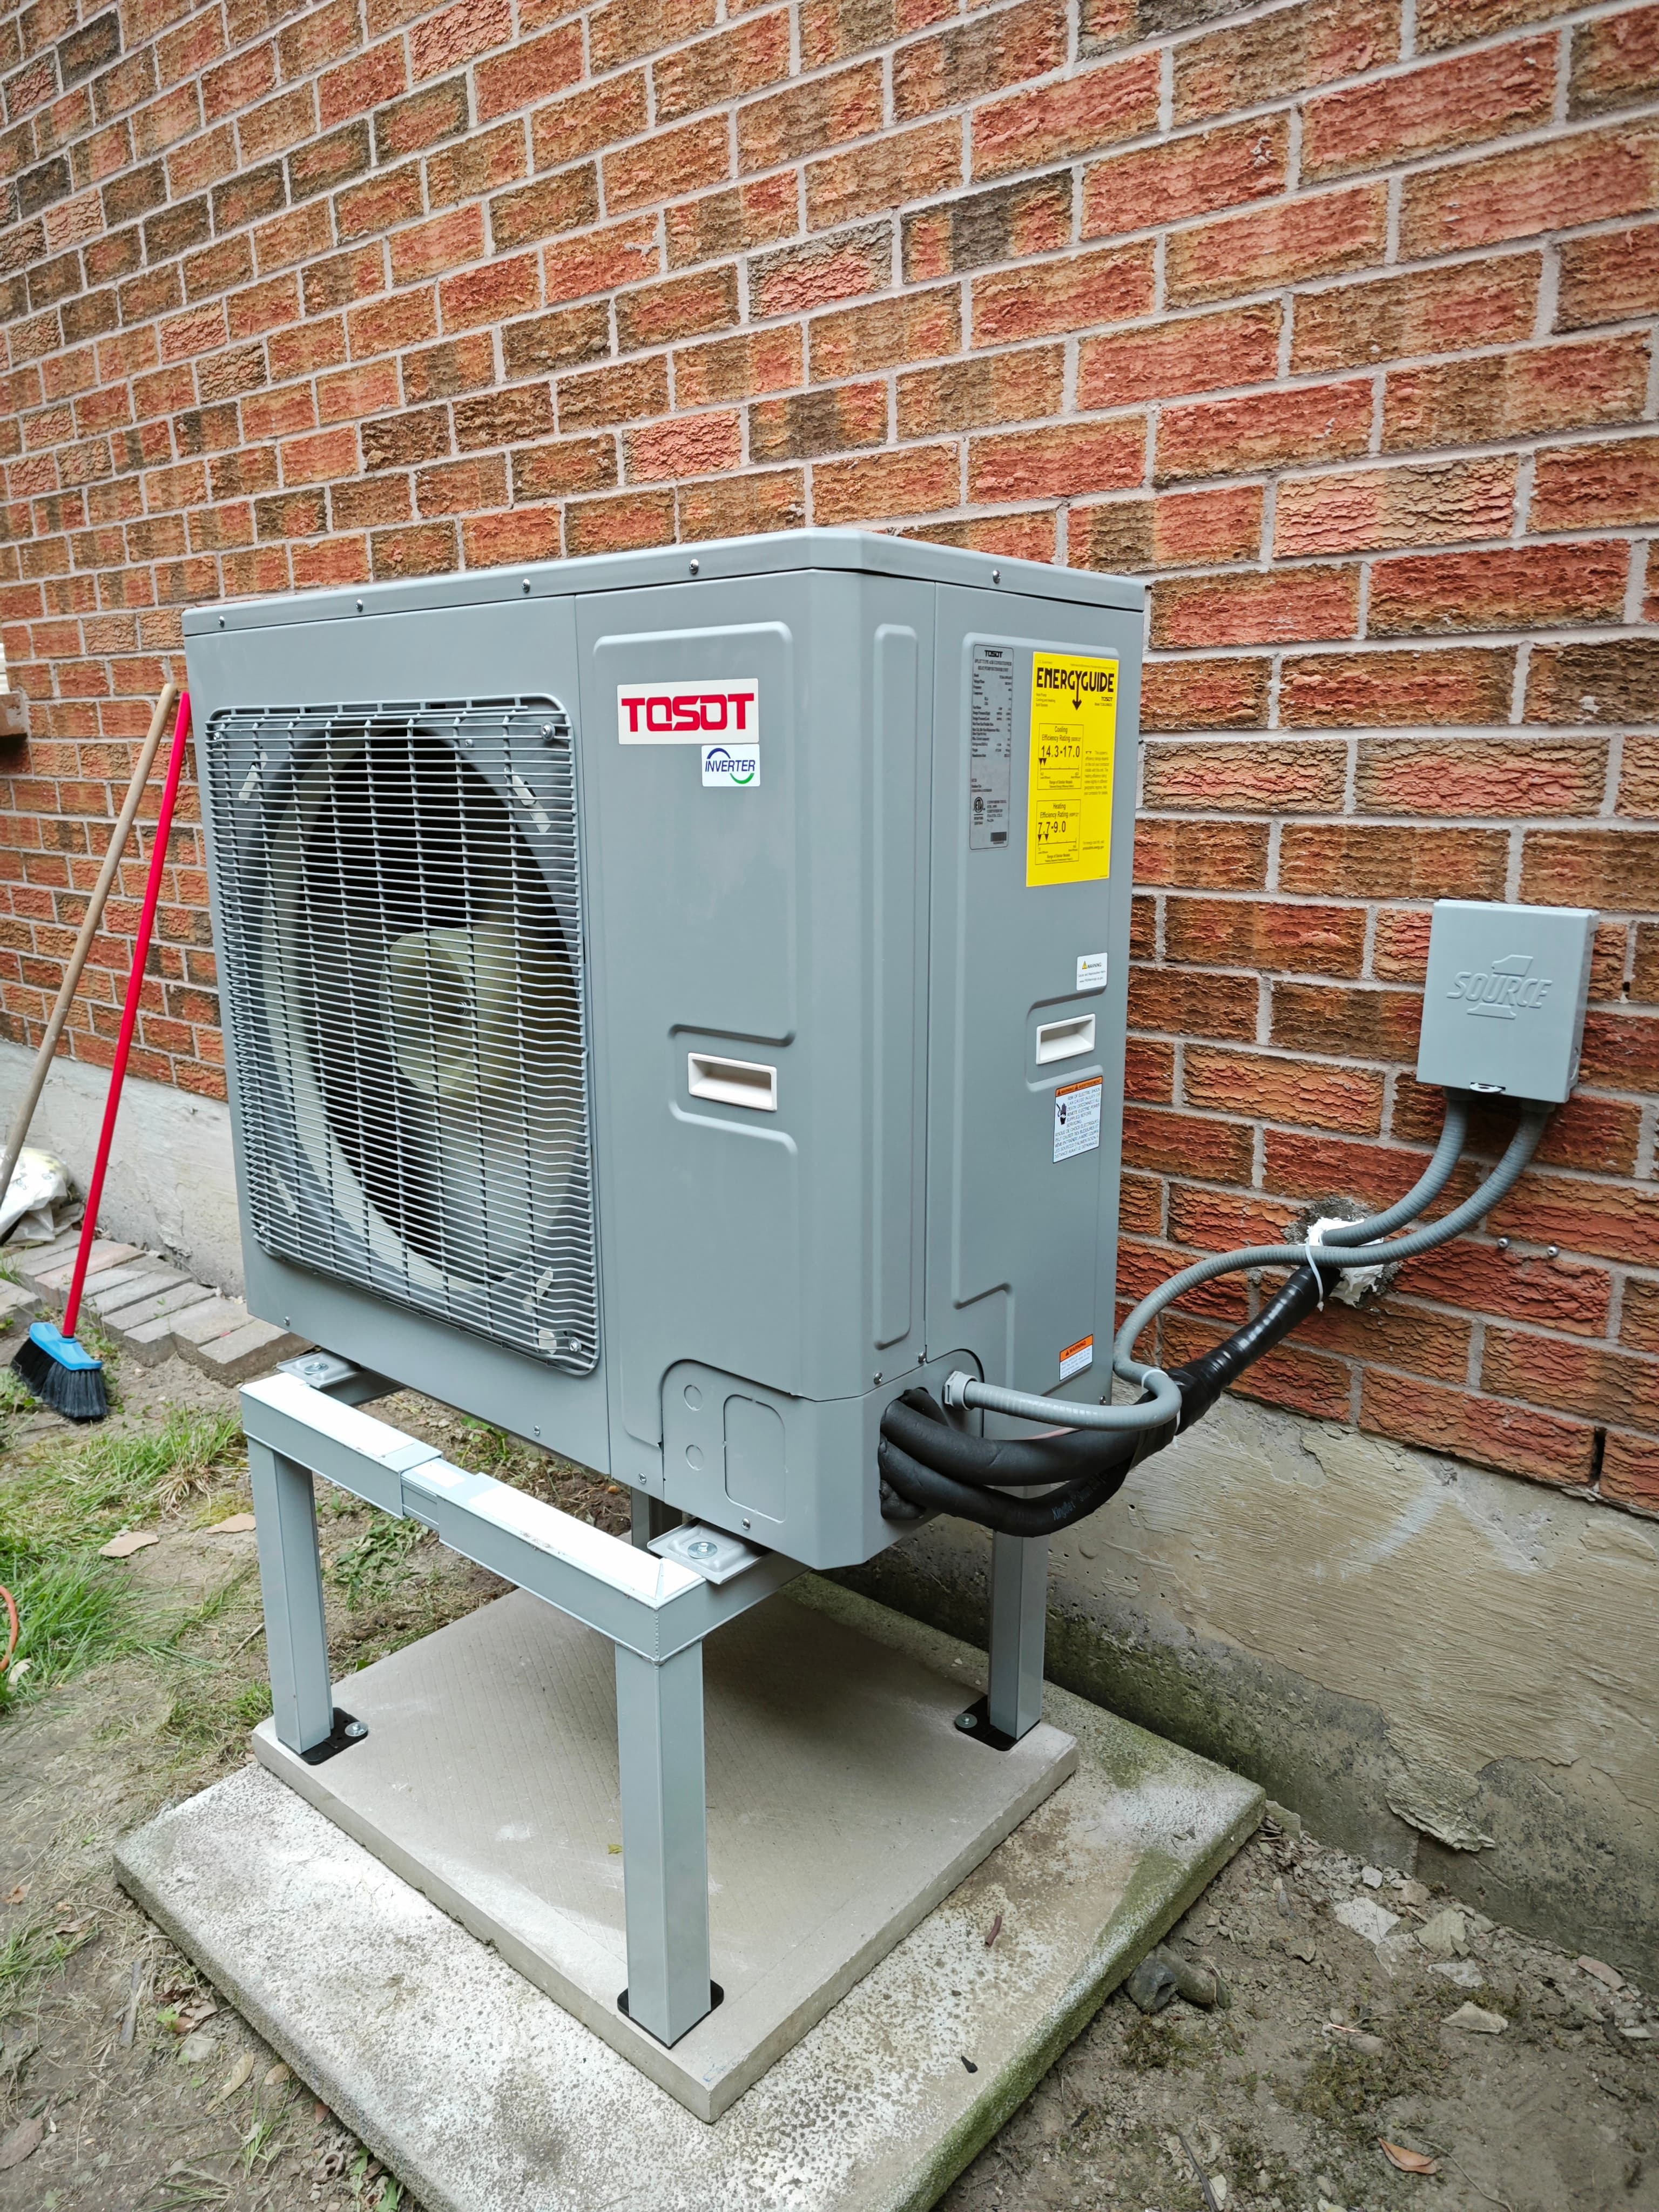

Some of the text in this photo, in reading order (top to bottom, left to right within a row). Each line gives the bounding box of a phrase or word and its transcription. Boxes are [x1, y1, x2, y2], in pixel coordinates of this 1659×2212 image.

[1036, 667, 1115, 693] ENERGYGUIDE
[621, 693, 754, 732] TOSOT
[1042, 734, 1058, 743] Efficiency
[1055, 726, 1068, 734] Cooling
[705, 760, 755, 772] INVERTER
[1447, 972, 1553, 1008] SOURCE
